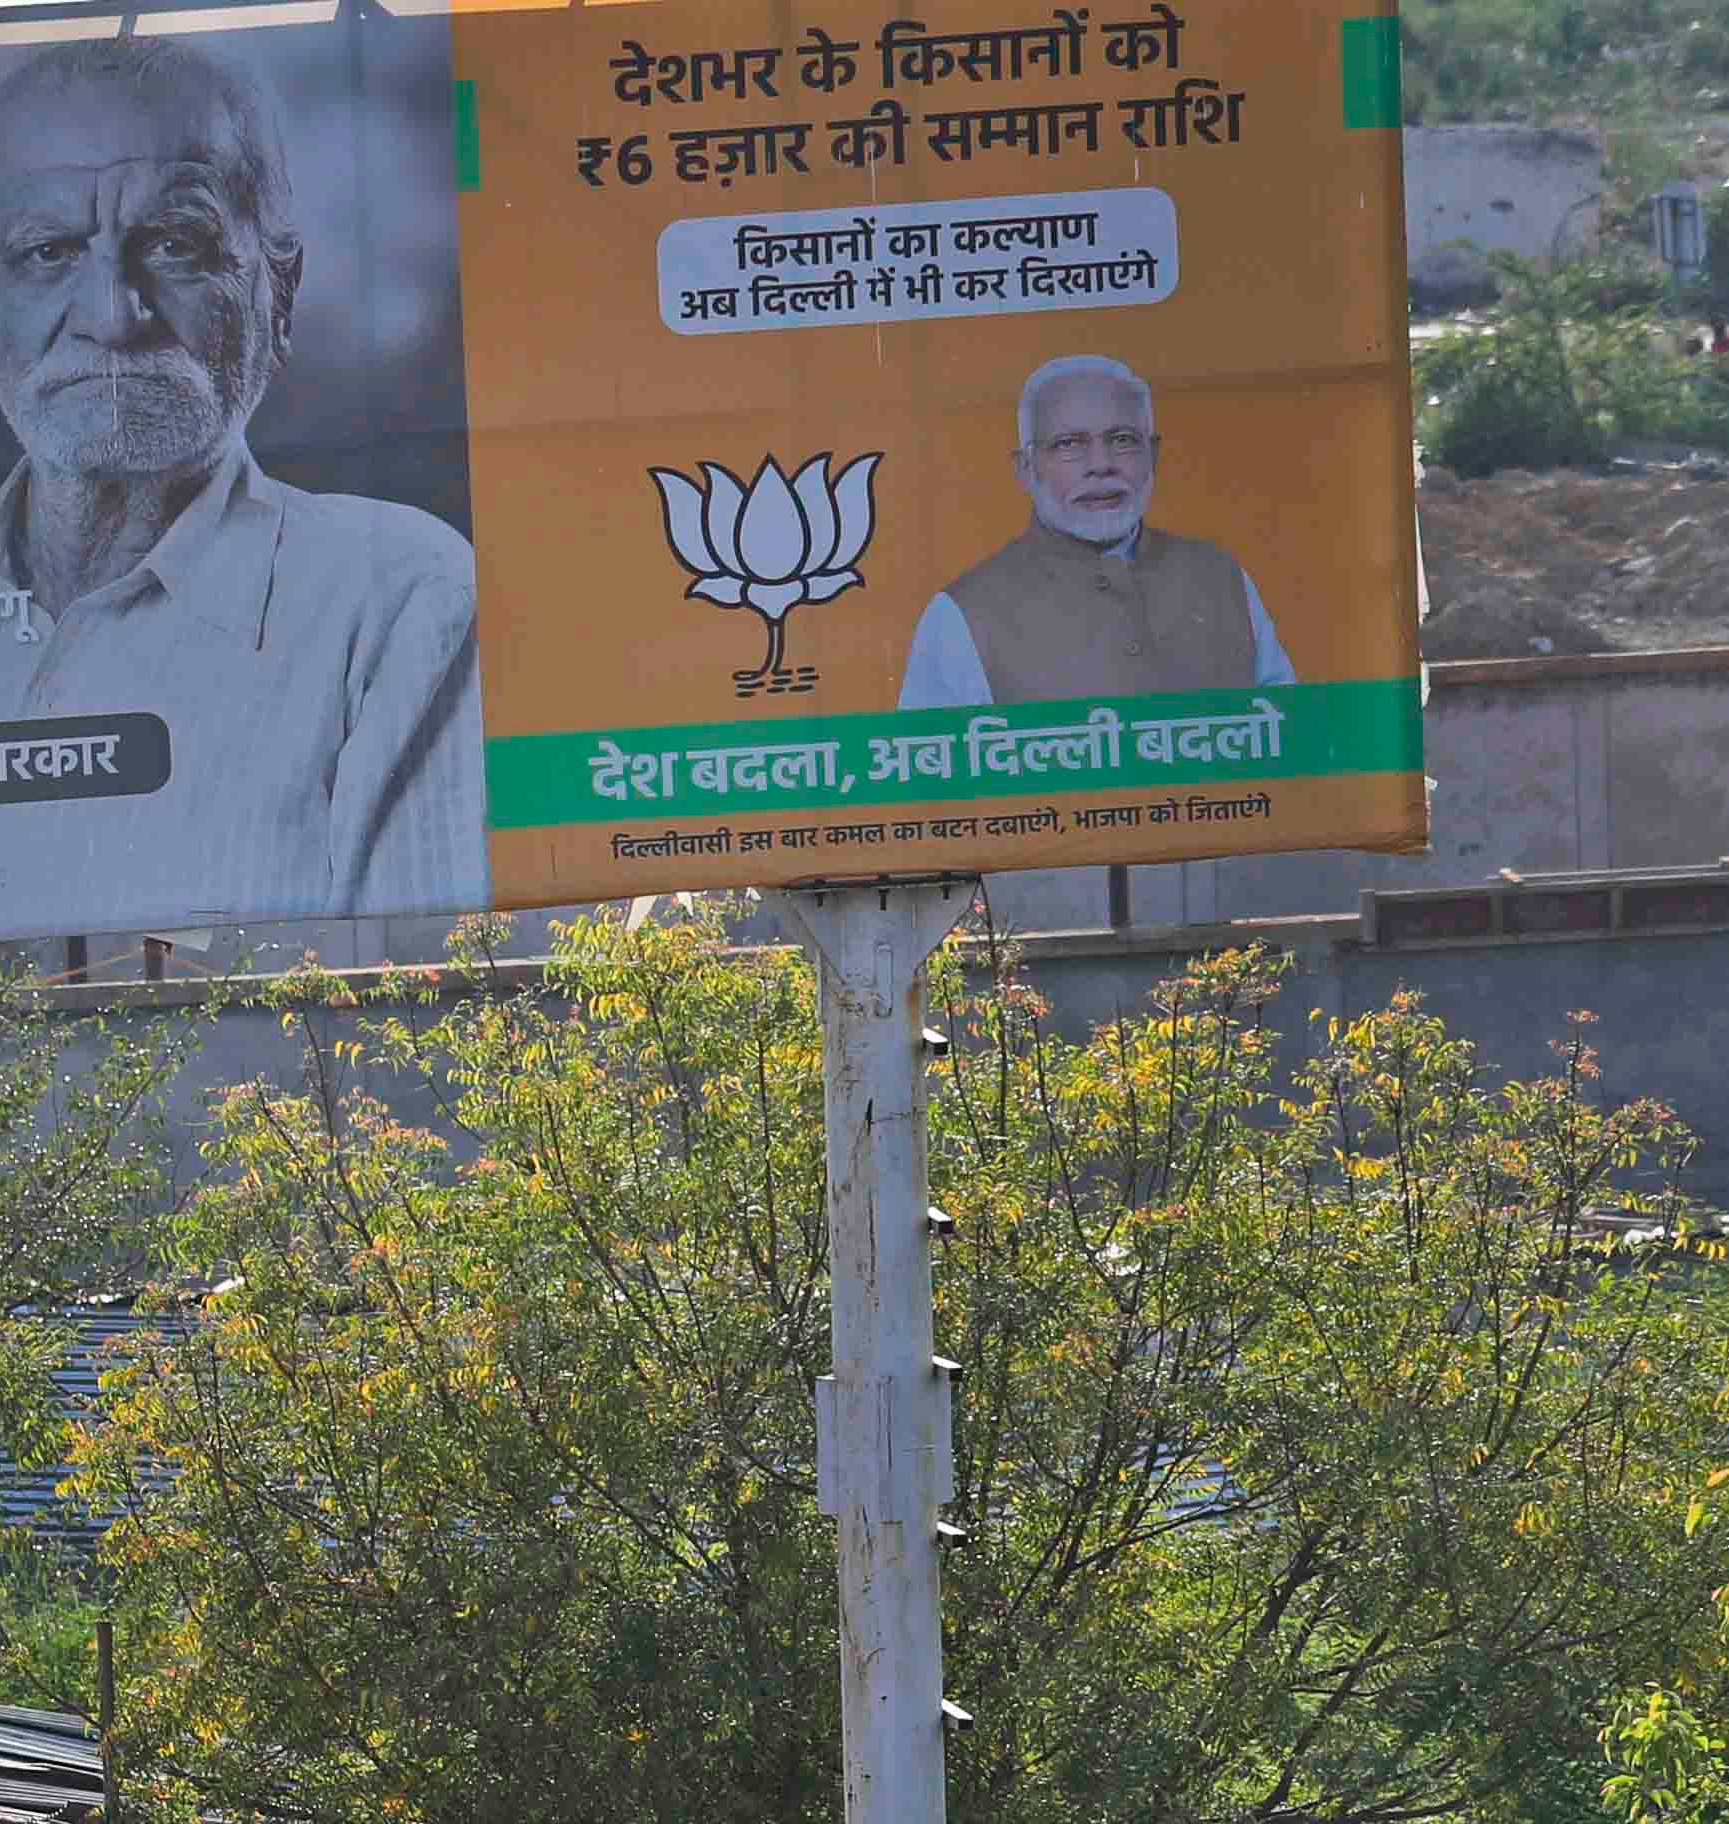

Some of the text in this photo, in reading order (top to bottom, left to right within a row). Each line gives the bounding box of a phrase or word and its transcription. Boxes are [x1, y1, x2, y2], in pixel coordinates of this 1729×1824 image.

[608, 3, 1186, 107] देशभर के किसानों को
[576, 78, 1246, 188] ₹6 हज़ार की सम्मान राशि
[732, 212, 1099, 272] किसानों का कल्याण
[680, 252, 1159, 321] अब दिल्ली में भी कर दिखाएंगे
[588, 740, 680, 801] देश
[868, 734, 957, 782] अब
[962, 707, 1125, 777] दिल्ली
[1131, 699, 1285, 764] बदलो
[610, 826, 733, 860] दिल्लीवासी
[738, 830, 773, 853] इस
[779, 827, 819, 849] बार
[822, 823, 886, 845] कमल
[890, 821, 925, 841] का
[928, 817, 979, 839] बटन
[1072, 806, 1143, 829] भाजपा
[1146, 797, 1181, 825] को
[1184, 792, 1272, 822] जिताएंगे
